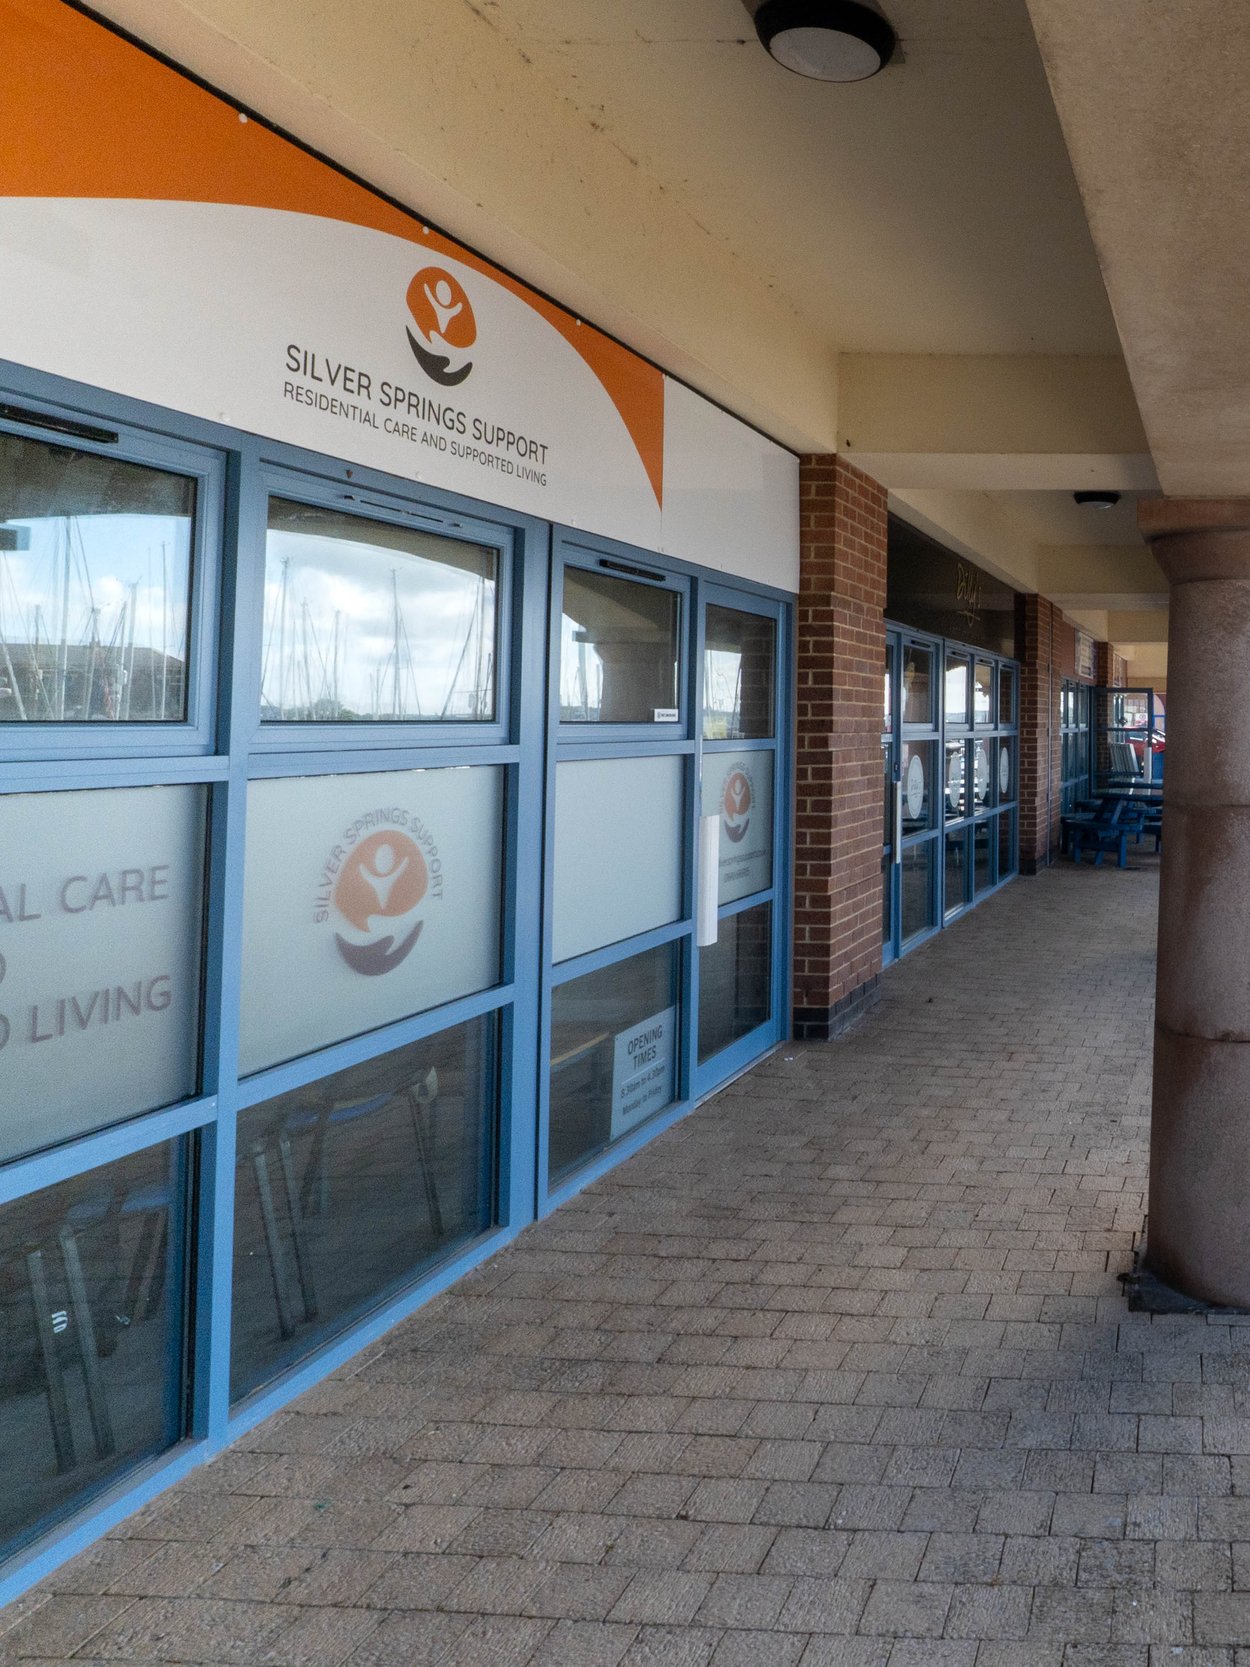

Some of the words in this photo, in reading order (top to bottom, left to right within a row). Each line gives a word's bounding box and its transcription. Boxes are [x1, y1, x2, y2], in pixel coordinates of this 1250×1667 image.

[284, 381, 379, 429] RESIDENTIAL
[384, 418, 418, 442] CARE
[421, 432, 447, 451] AND
[450, 441, 514, 475] SUPPORTED
[516, 465, 547, 487] LIVING
[285, 344, 371, 400] SILVER
[379, 381, 467, 434] SPRINGS
[472, 418, 549, 465] SUPPORT
[59, 864, 170, 914] CARE
[313, 844, 347, 923] SILVER
[344, 807, 410, 845] SPRINGS
[410, 817, 443, 900] SUPPORT
[30, 975, 172, 1043] LIVING
[627, 1024, 663, 1055] OPENING
[633, 1045, 657, 1070] TIMES
